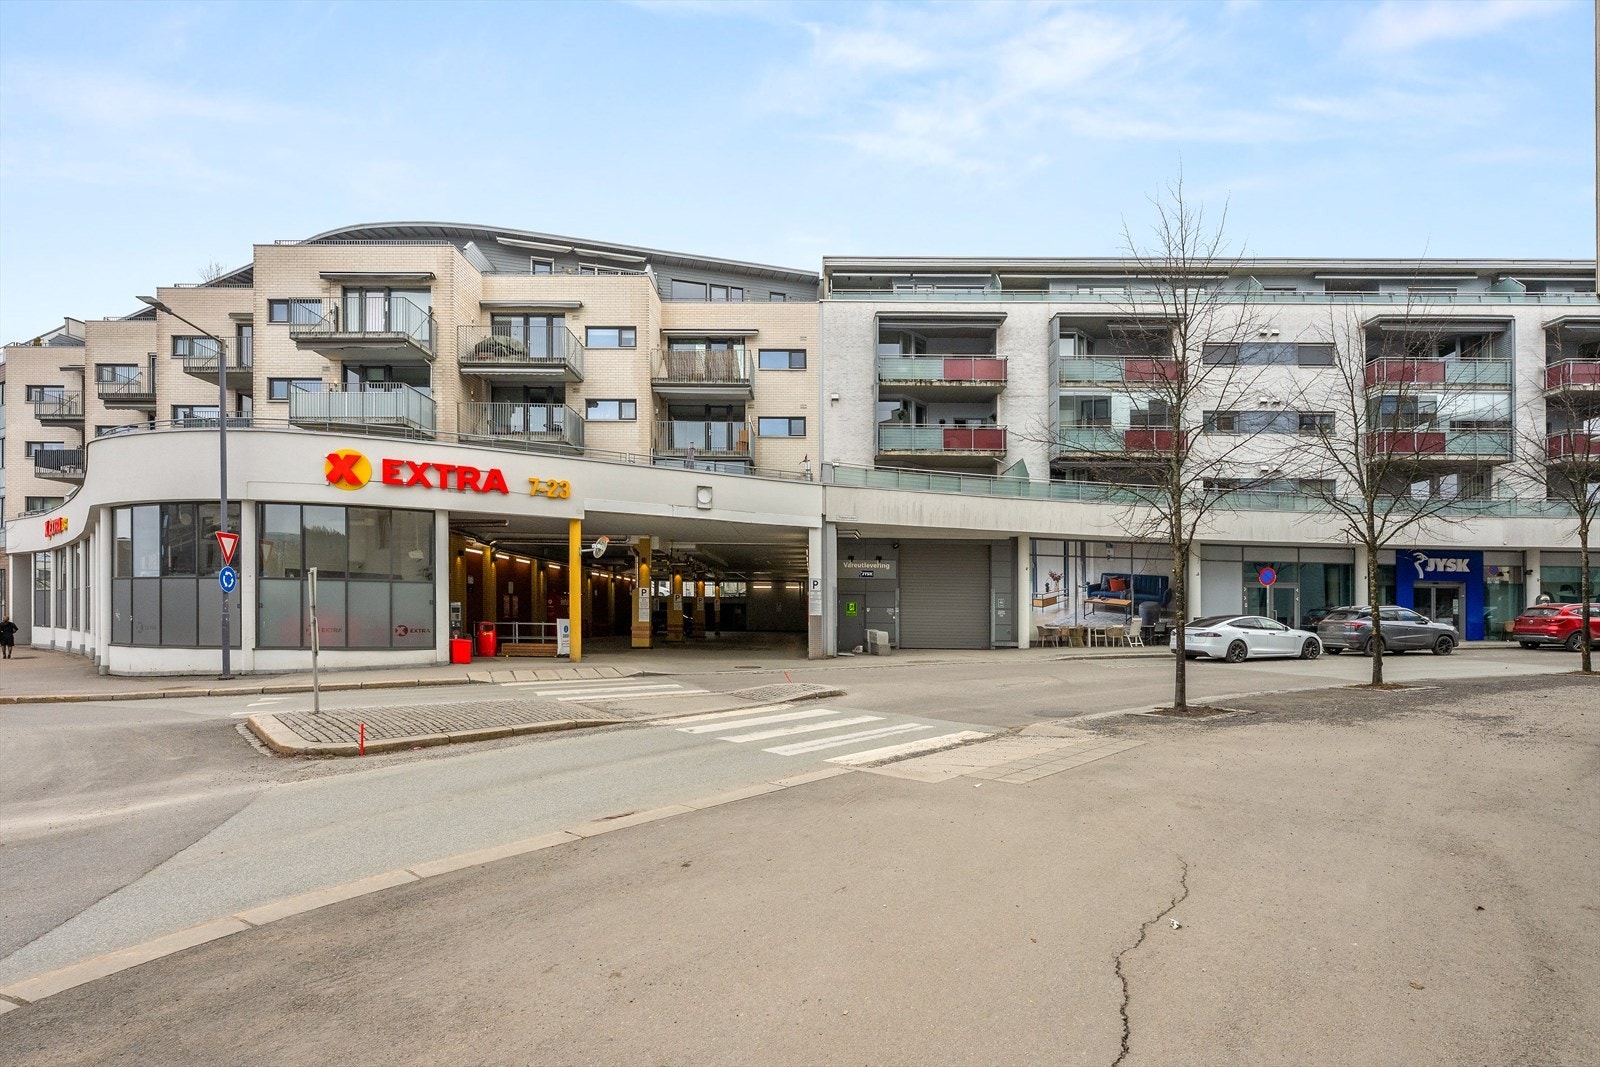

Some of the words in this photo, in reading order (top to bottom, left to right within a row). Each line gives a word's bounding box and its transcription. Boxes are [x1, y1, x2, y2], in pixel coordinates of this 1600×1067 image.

[382, 458, 510, 495] EXTRA
[528, 477, 571, 499] 7-23
[1425, 558, 1470, 572] JYSK
[812, 580, 819, 589] P
[641, 588, 647, 597] P
[675, 594, 680, 602] P
